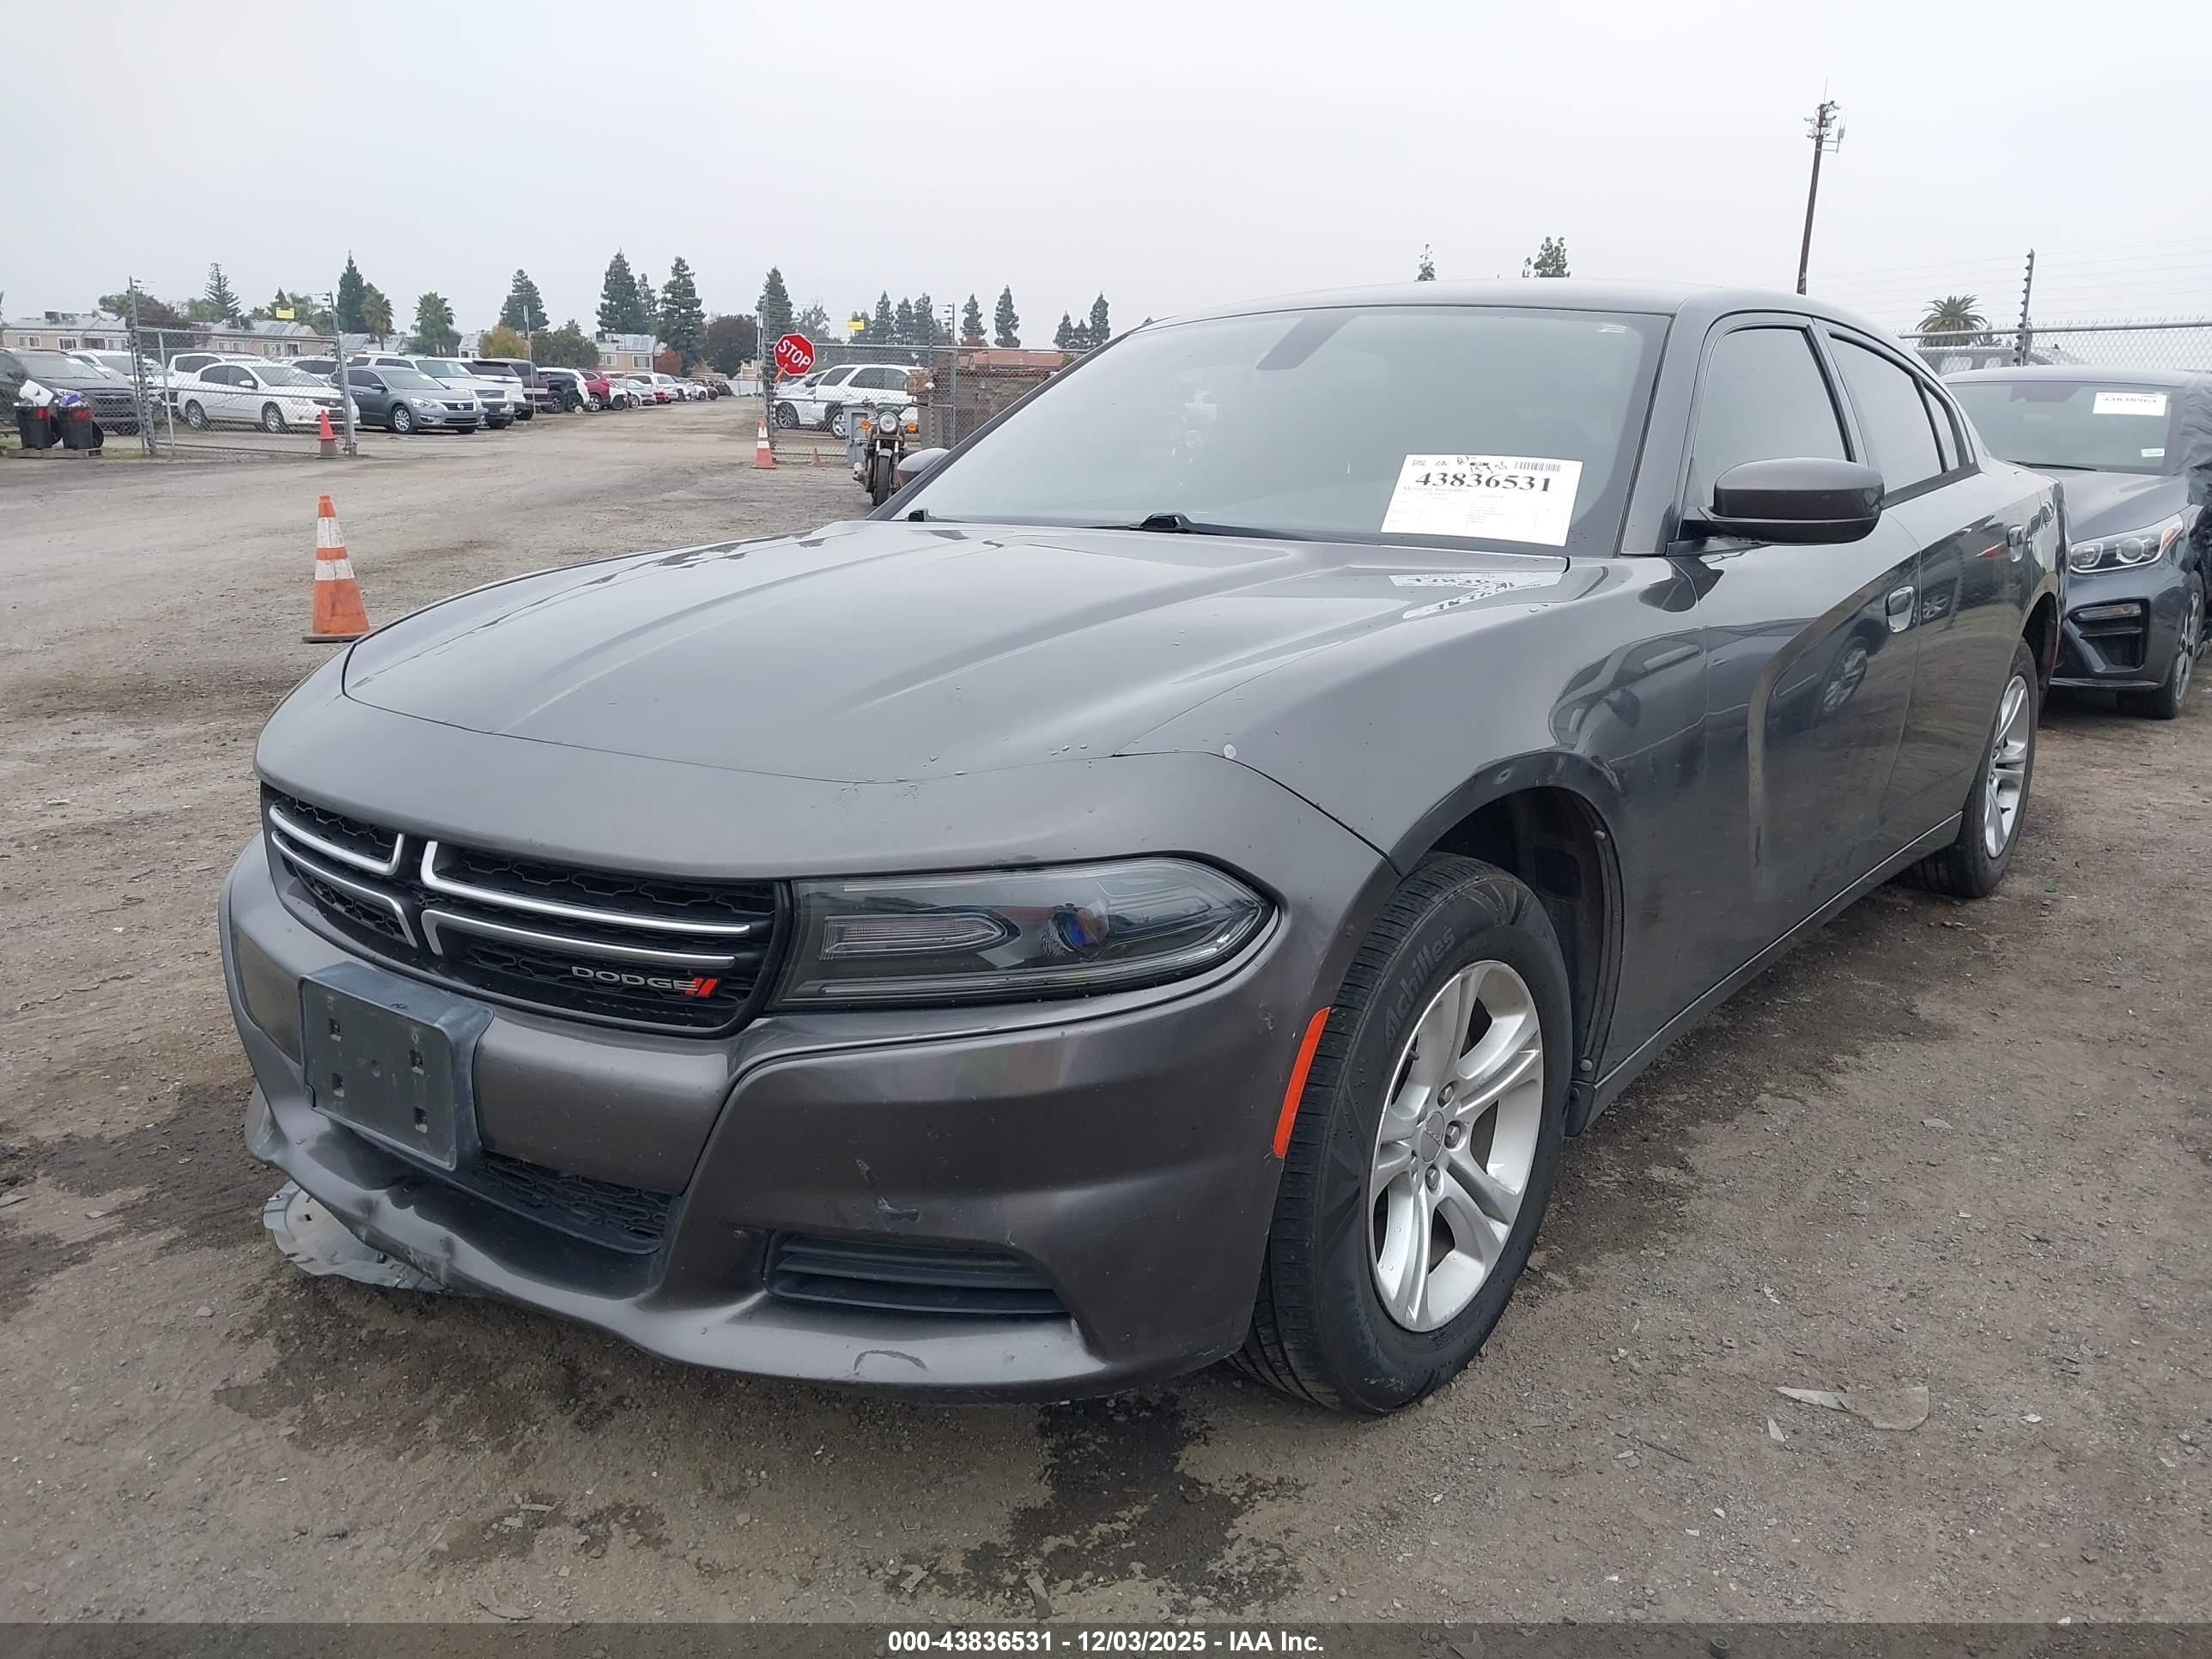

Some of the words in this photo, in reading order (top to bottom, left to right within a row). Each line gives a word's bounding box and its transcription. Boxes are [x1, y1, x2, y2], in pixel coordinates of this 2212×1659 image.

[778, 339, 811, 368] STOP
[1415, 472, 1551, 492] 43836531
[571, 966, 699, 991] DODGE
[1385, 926, 1455, 1053] Achilles
